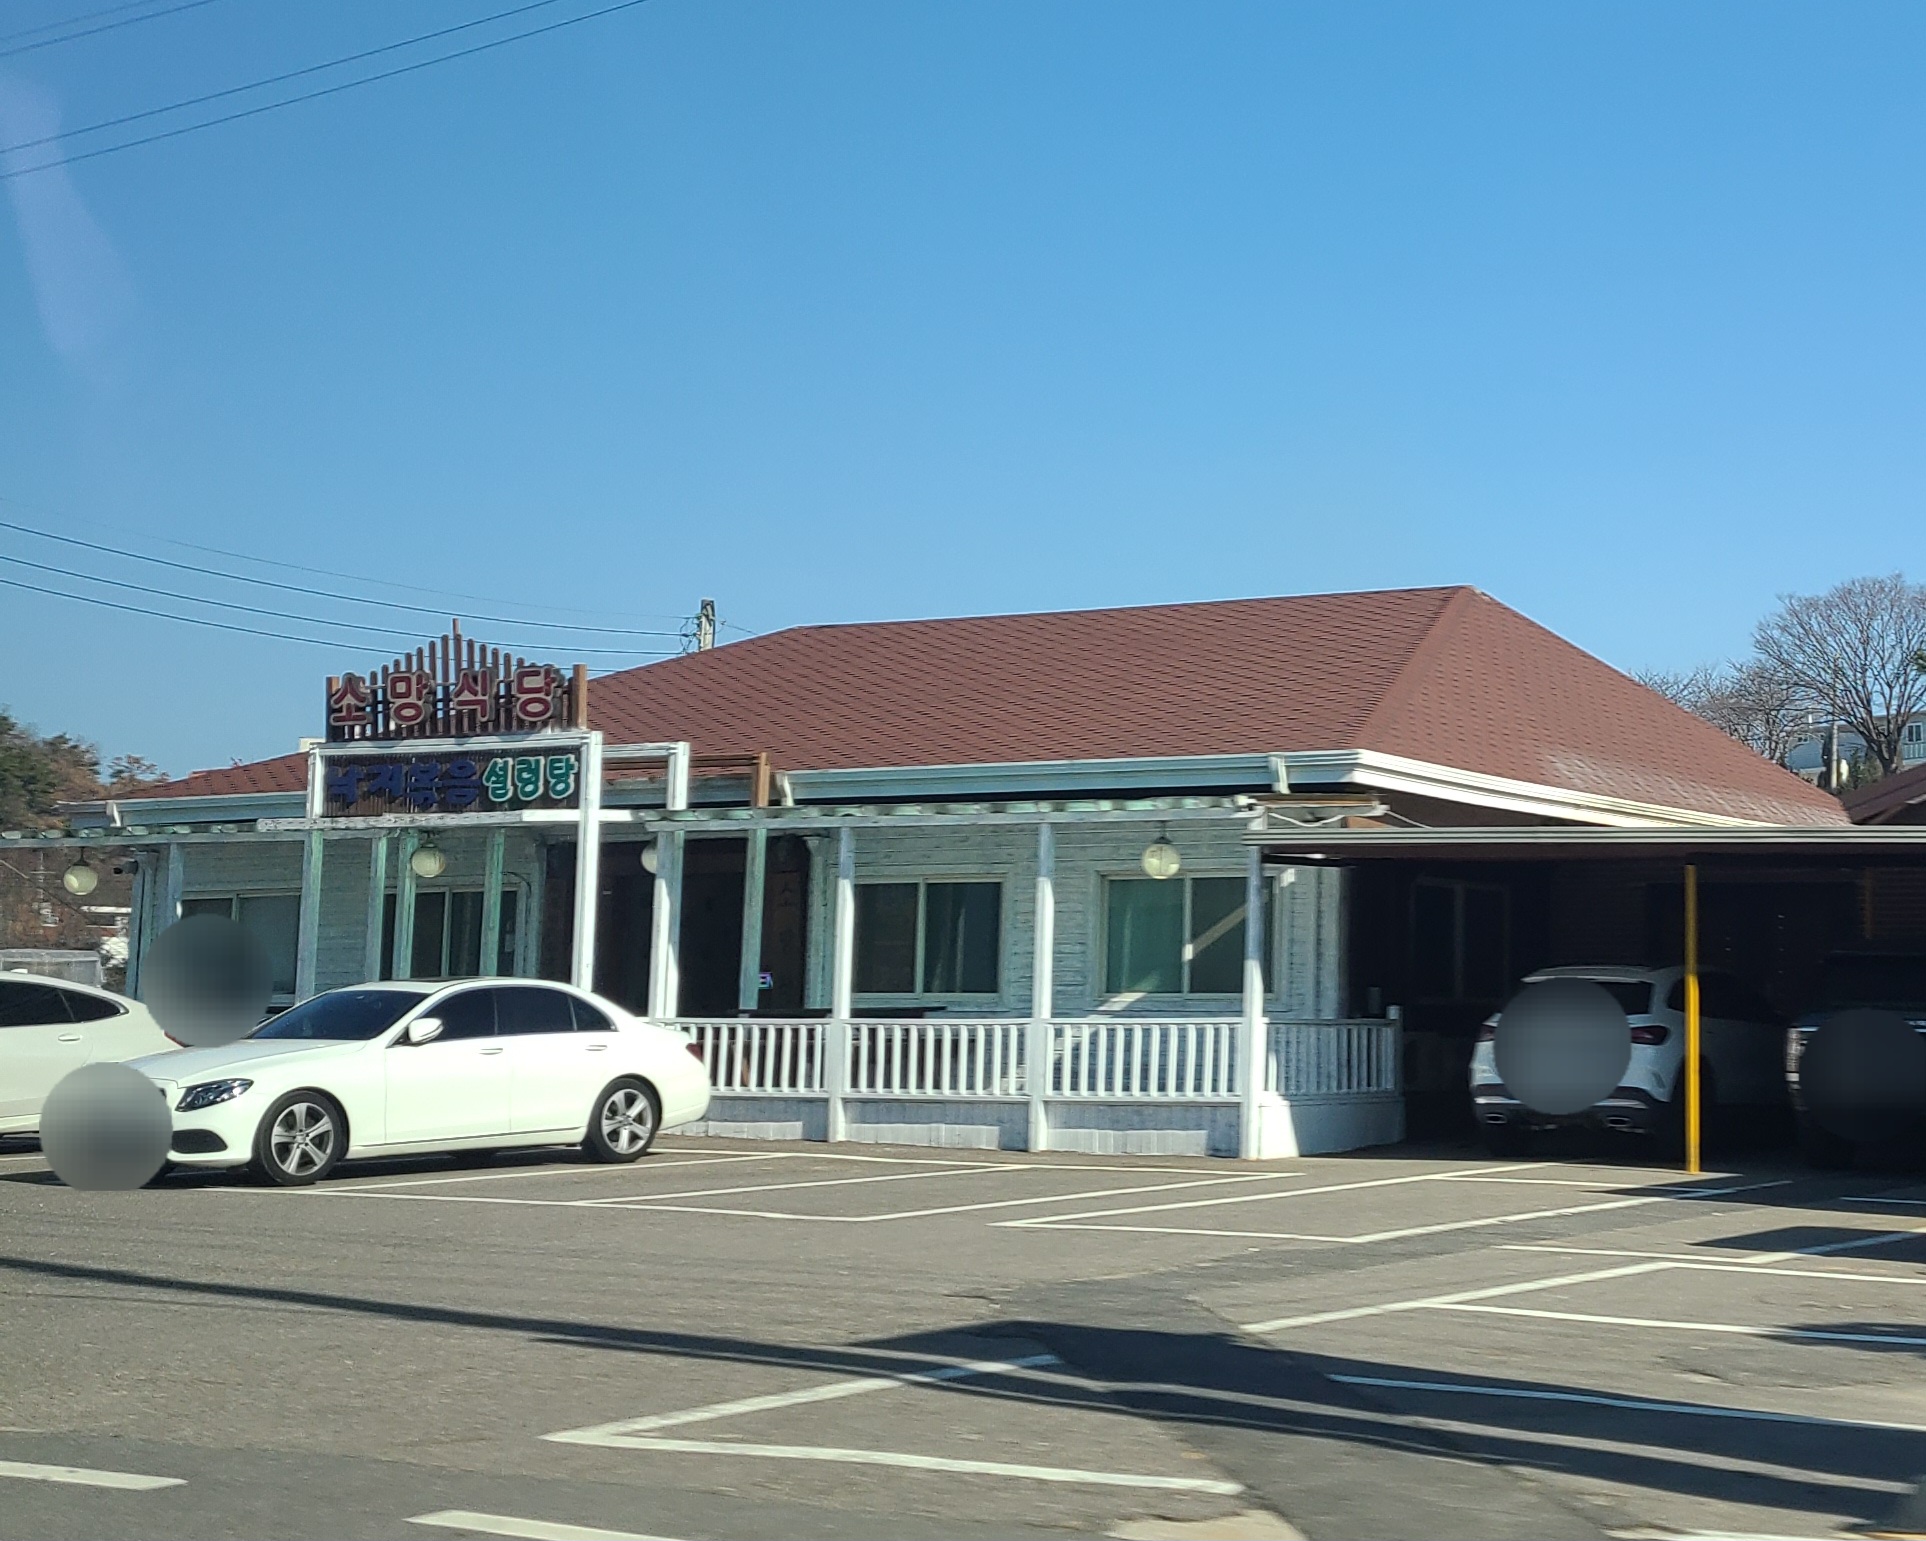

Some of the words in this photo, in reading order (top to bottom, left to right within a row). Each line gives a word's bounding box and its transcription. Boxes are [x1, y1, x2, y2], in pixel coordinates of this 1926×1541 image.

[330, 668, 557, 725] 소망식당
[327, 760, 480, 807] 낙지볶음
[483, 754, 578, 801] 설렁탕
